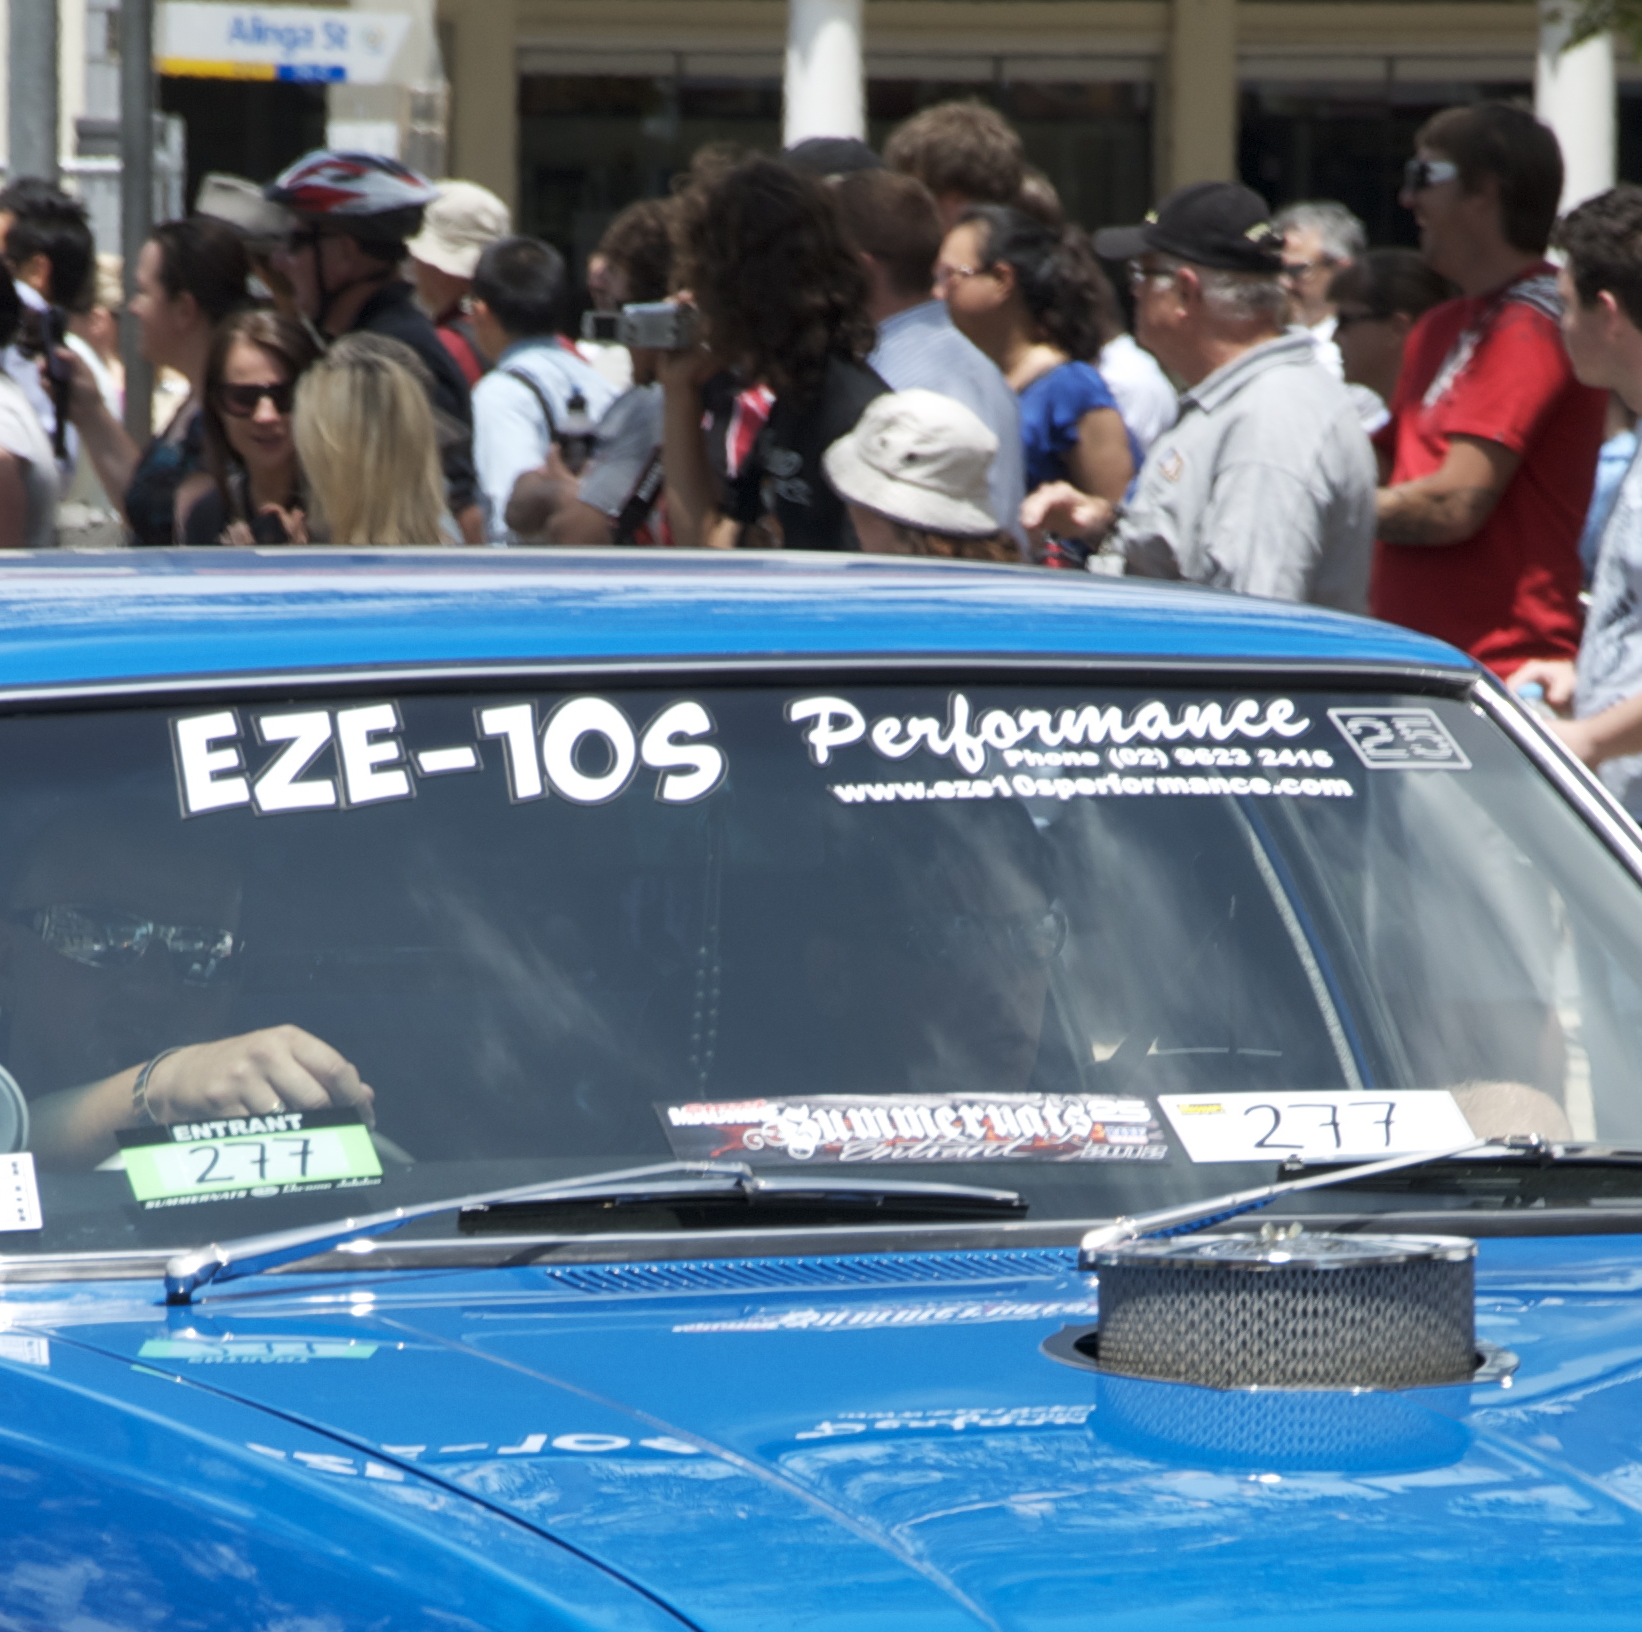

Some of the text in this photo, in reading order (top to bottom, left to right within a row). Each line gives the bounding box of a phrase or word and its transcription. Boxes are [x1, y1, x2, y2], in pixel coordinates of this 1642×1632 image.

[227, 14, 349, 60] Alinga St
[172, 695, 728, 816] EZE-10S
[788, 693, 1311, 773] Performance
[1345, 716, 1454, 760] 25
[1003, 747, 1100, 768] Phone
[832, 772, 1355, 802] www.eze10sperformance.com
[172, 1113, 303, 1141] ENTRANT
[1243, 1101, 1398, 1150] 277
[189, 1137, 314, 1184] 277
